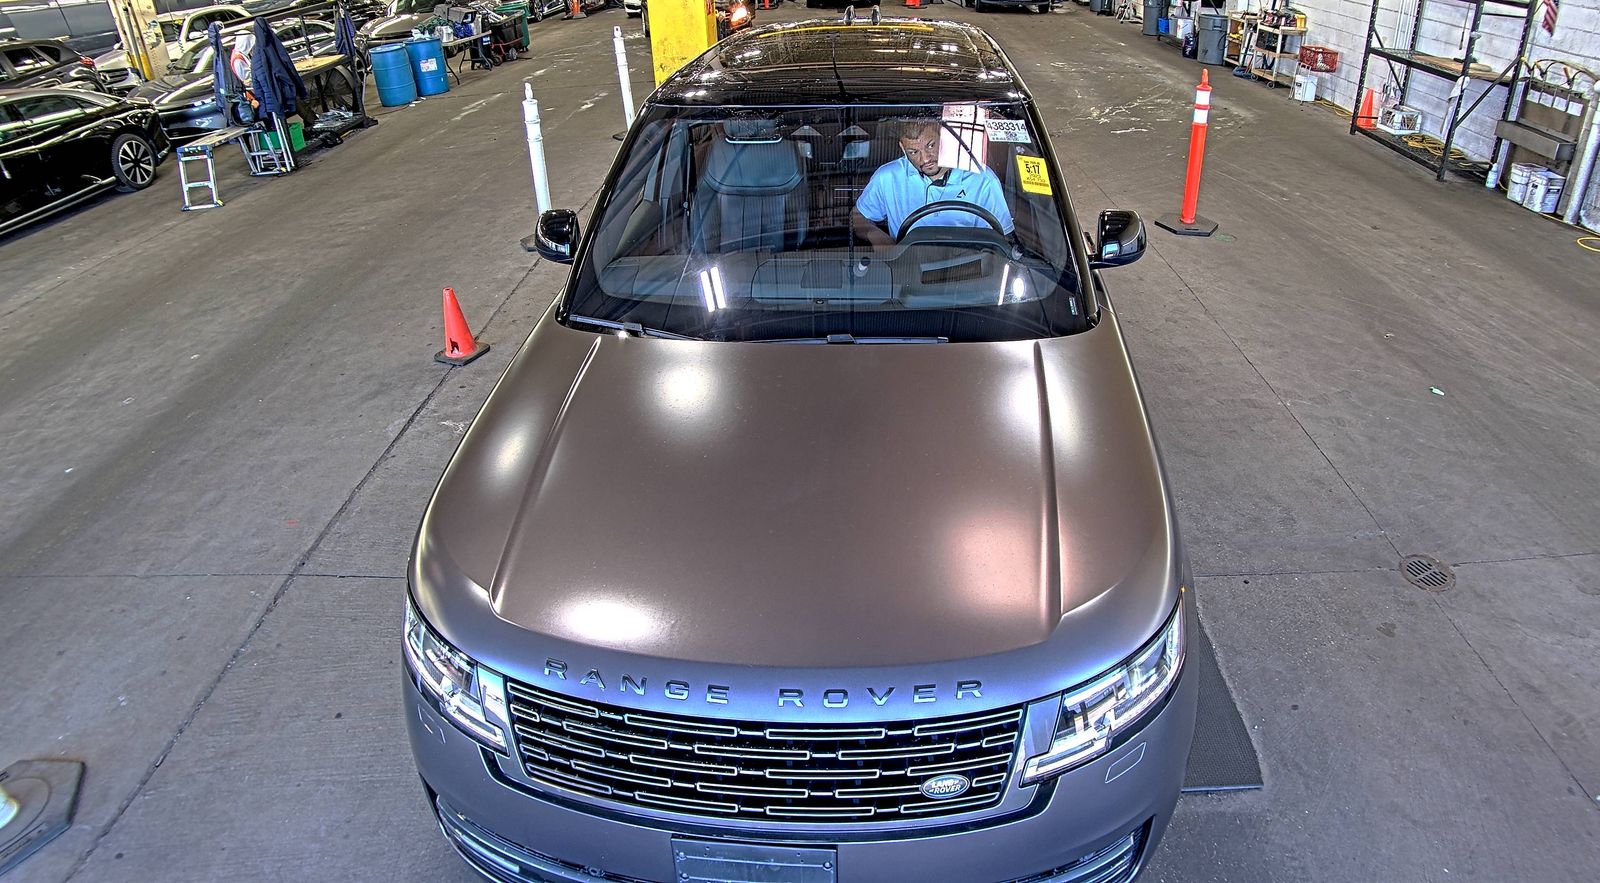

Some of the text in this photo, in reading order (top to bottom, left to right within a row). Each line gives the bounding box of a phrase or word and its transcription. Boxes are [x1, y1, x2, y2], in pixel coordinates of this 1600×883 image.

[986, 121, 1027, 131] 4383314
[543, 656, 983, 709] RANGE ROVER
[931, 779, 957, 788] LAND
[933, 784, 961, 794] ROVER
